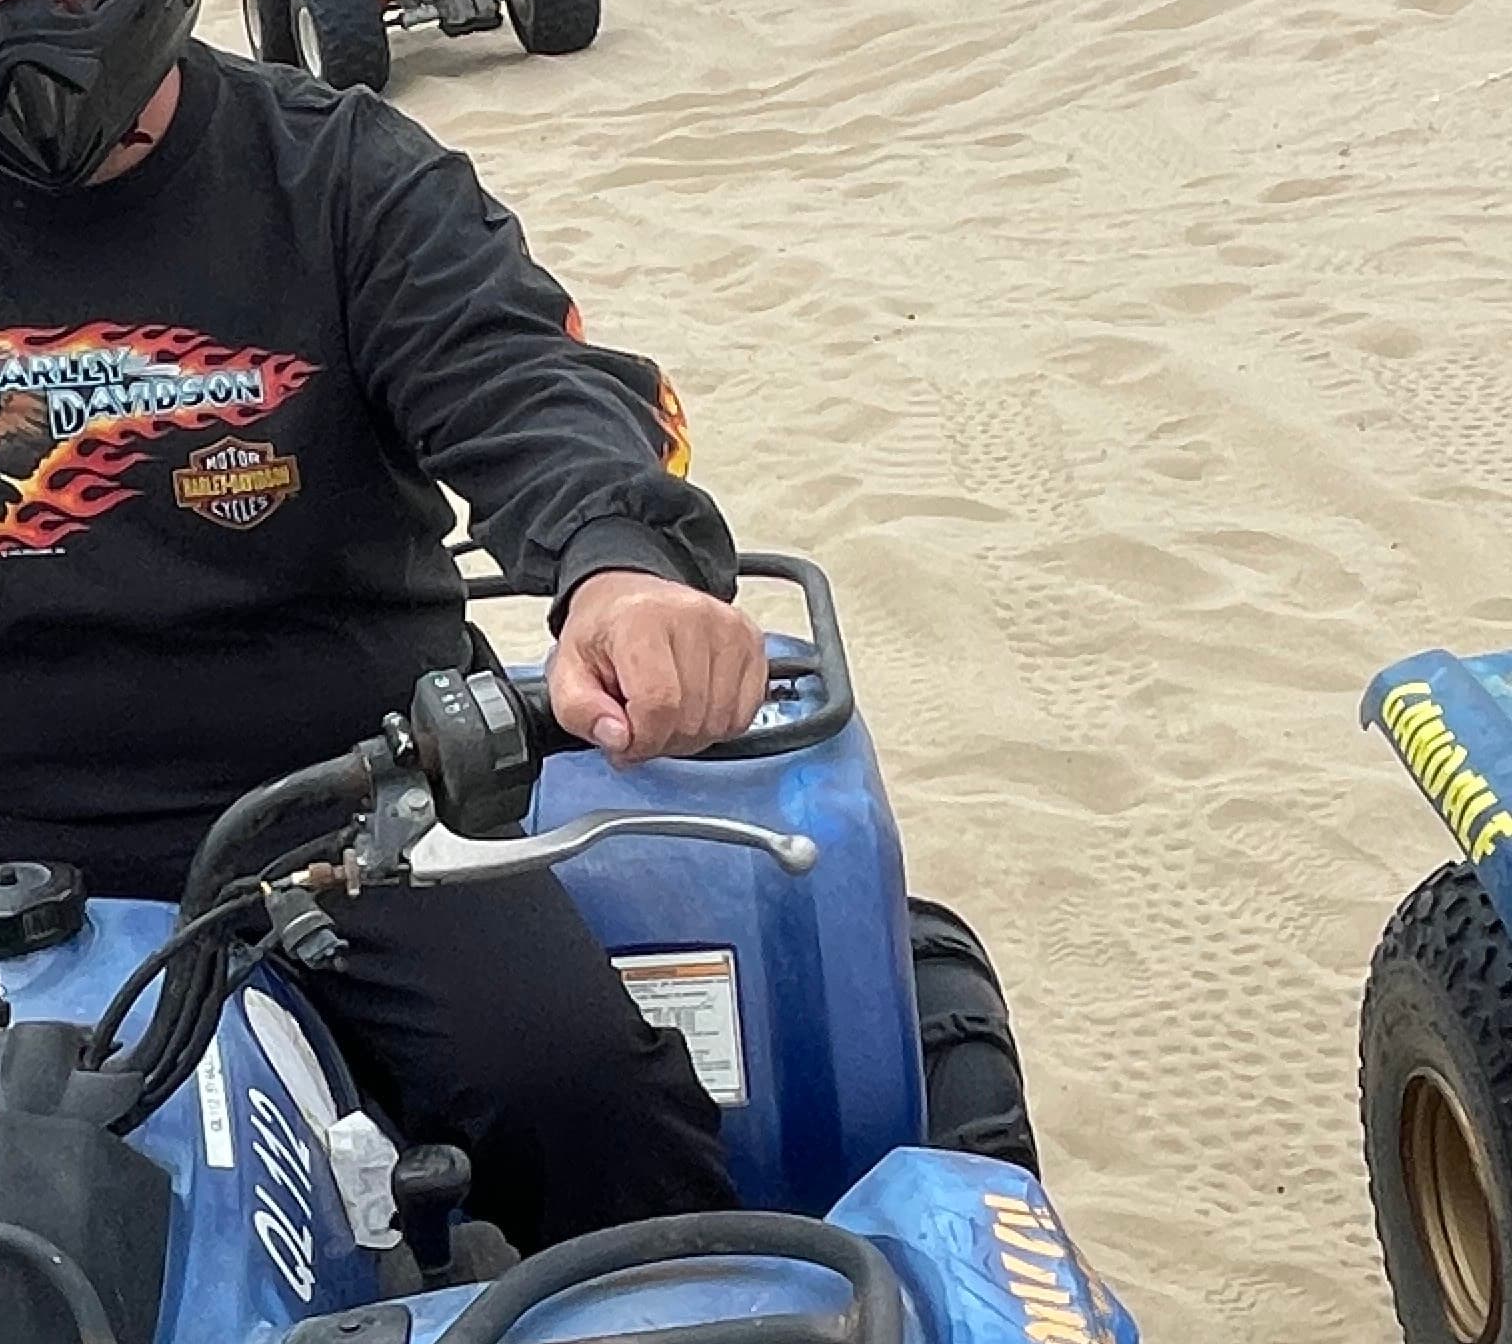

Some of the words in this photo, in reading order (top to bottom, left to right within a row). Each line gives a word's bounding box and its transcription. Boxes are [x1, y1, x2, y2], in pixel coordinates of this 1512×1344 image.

[46, 367, 264, 440] DAVIDSON
[206, 446, 260, 471] MOTOR
[211, 495, 268, 524] CYCLES
[247, 1087, 313, 1220] 112
[253, 1184, 314, 1303] QL
